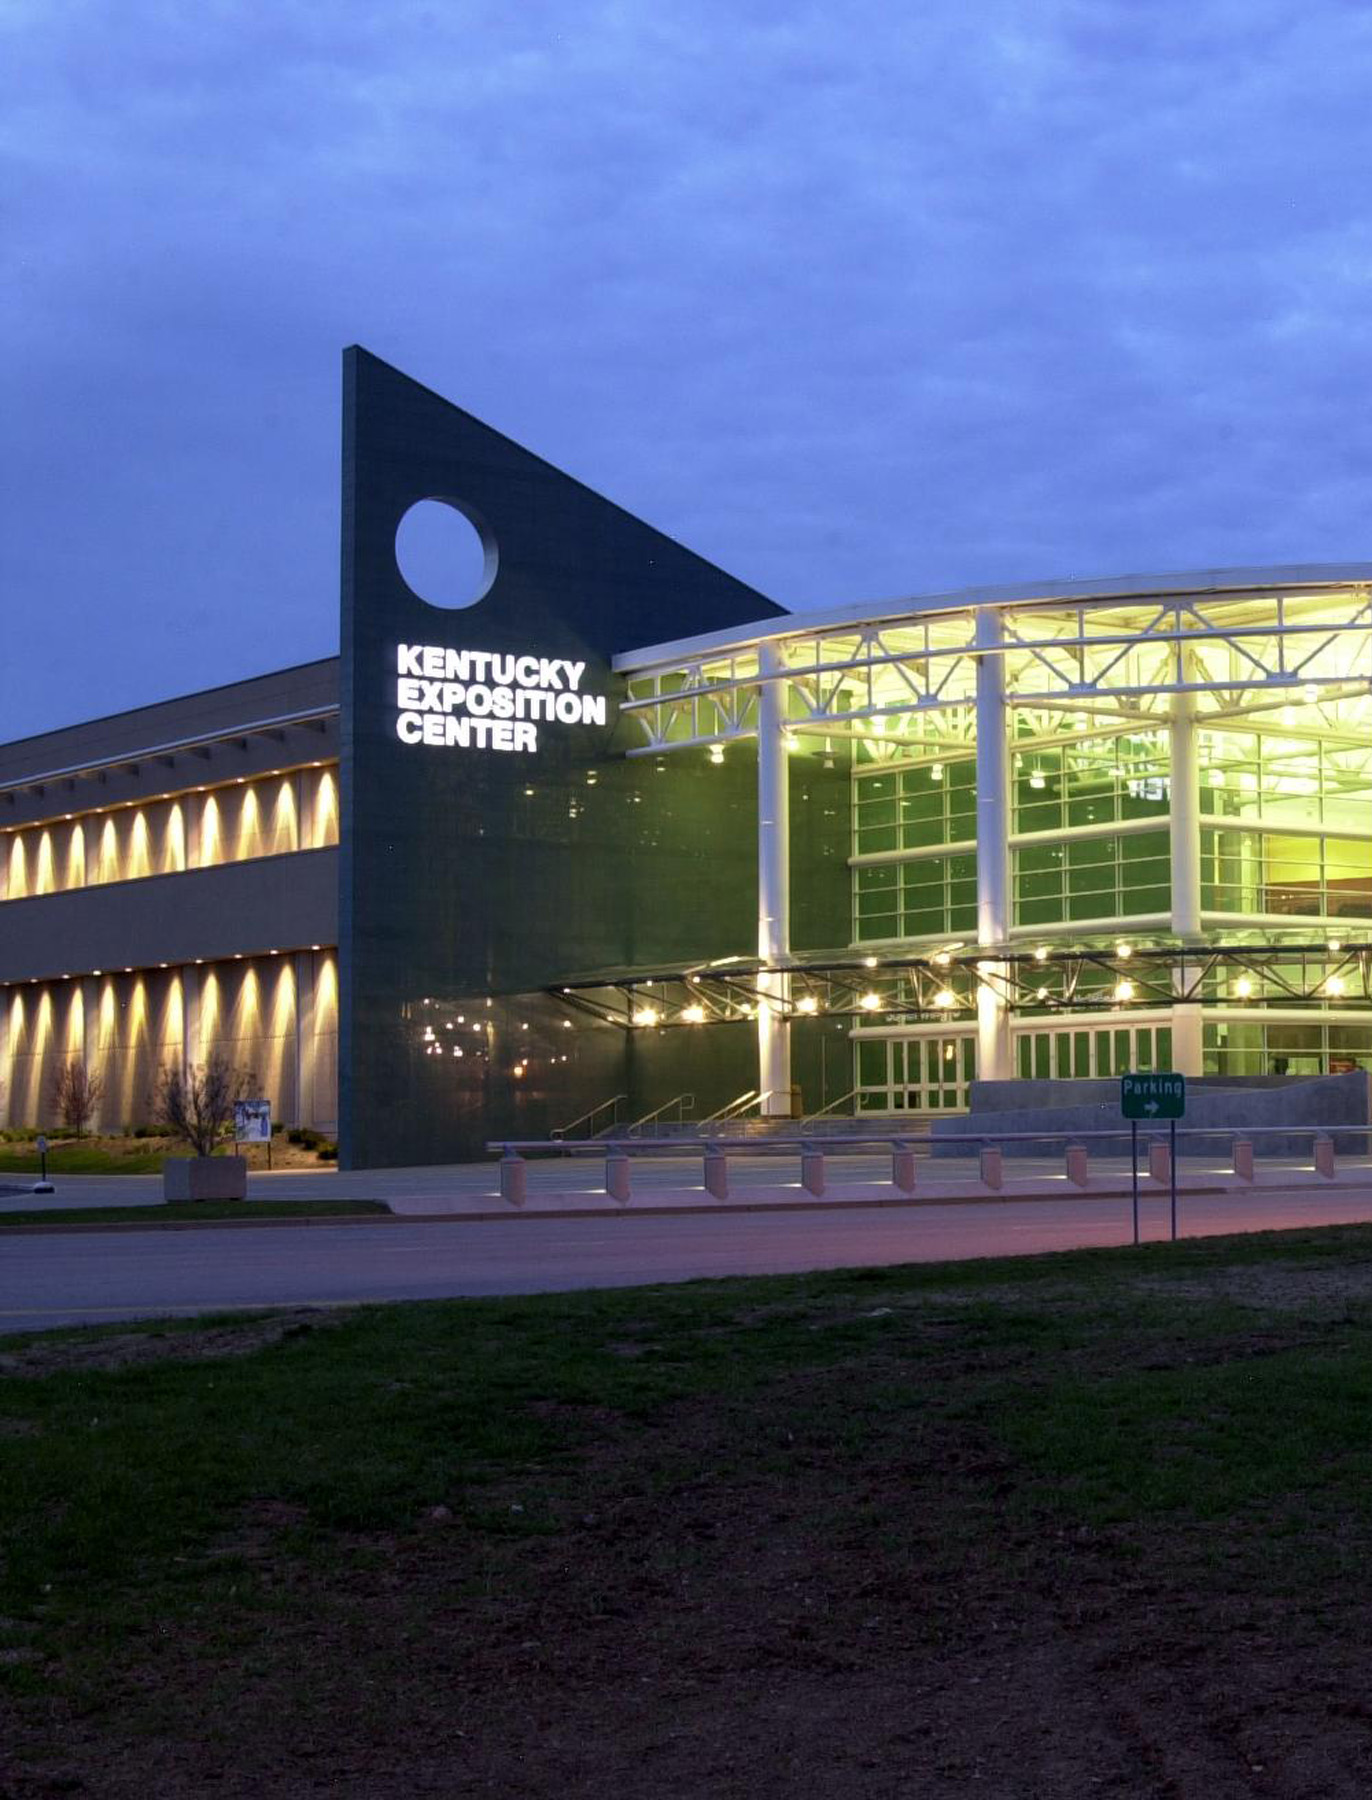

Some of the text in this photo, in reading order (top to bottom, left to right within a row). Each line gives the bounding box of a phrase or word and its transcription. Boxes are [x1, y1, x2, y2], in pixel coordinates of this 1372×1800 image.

[397, 644, 585, 691] KENTUCKY
[397, 677, 606, 725] EXPOSITION
[396, 712, 538, 752] CENTER
[1123, 1080, 1183, 1098] Parking
